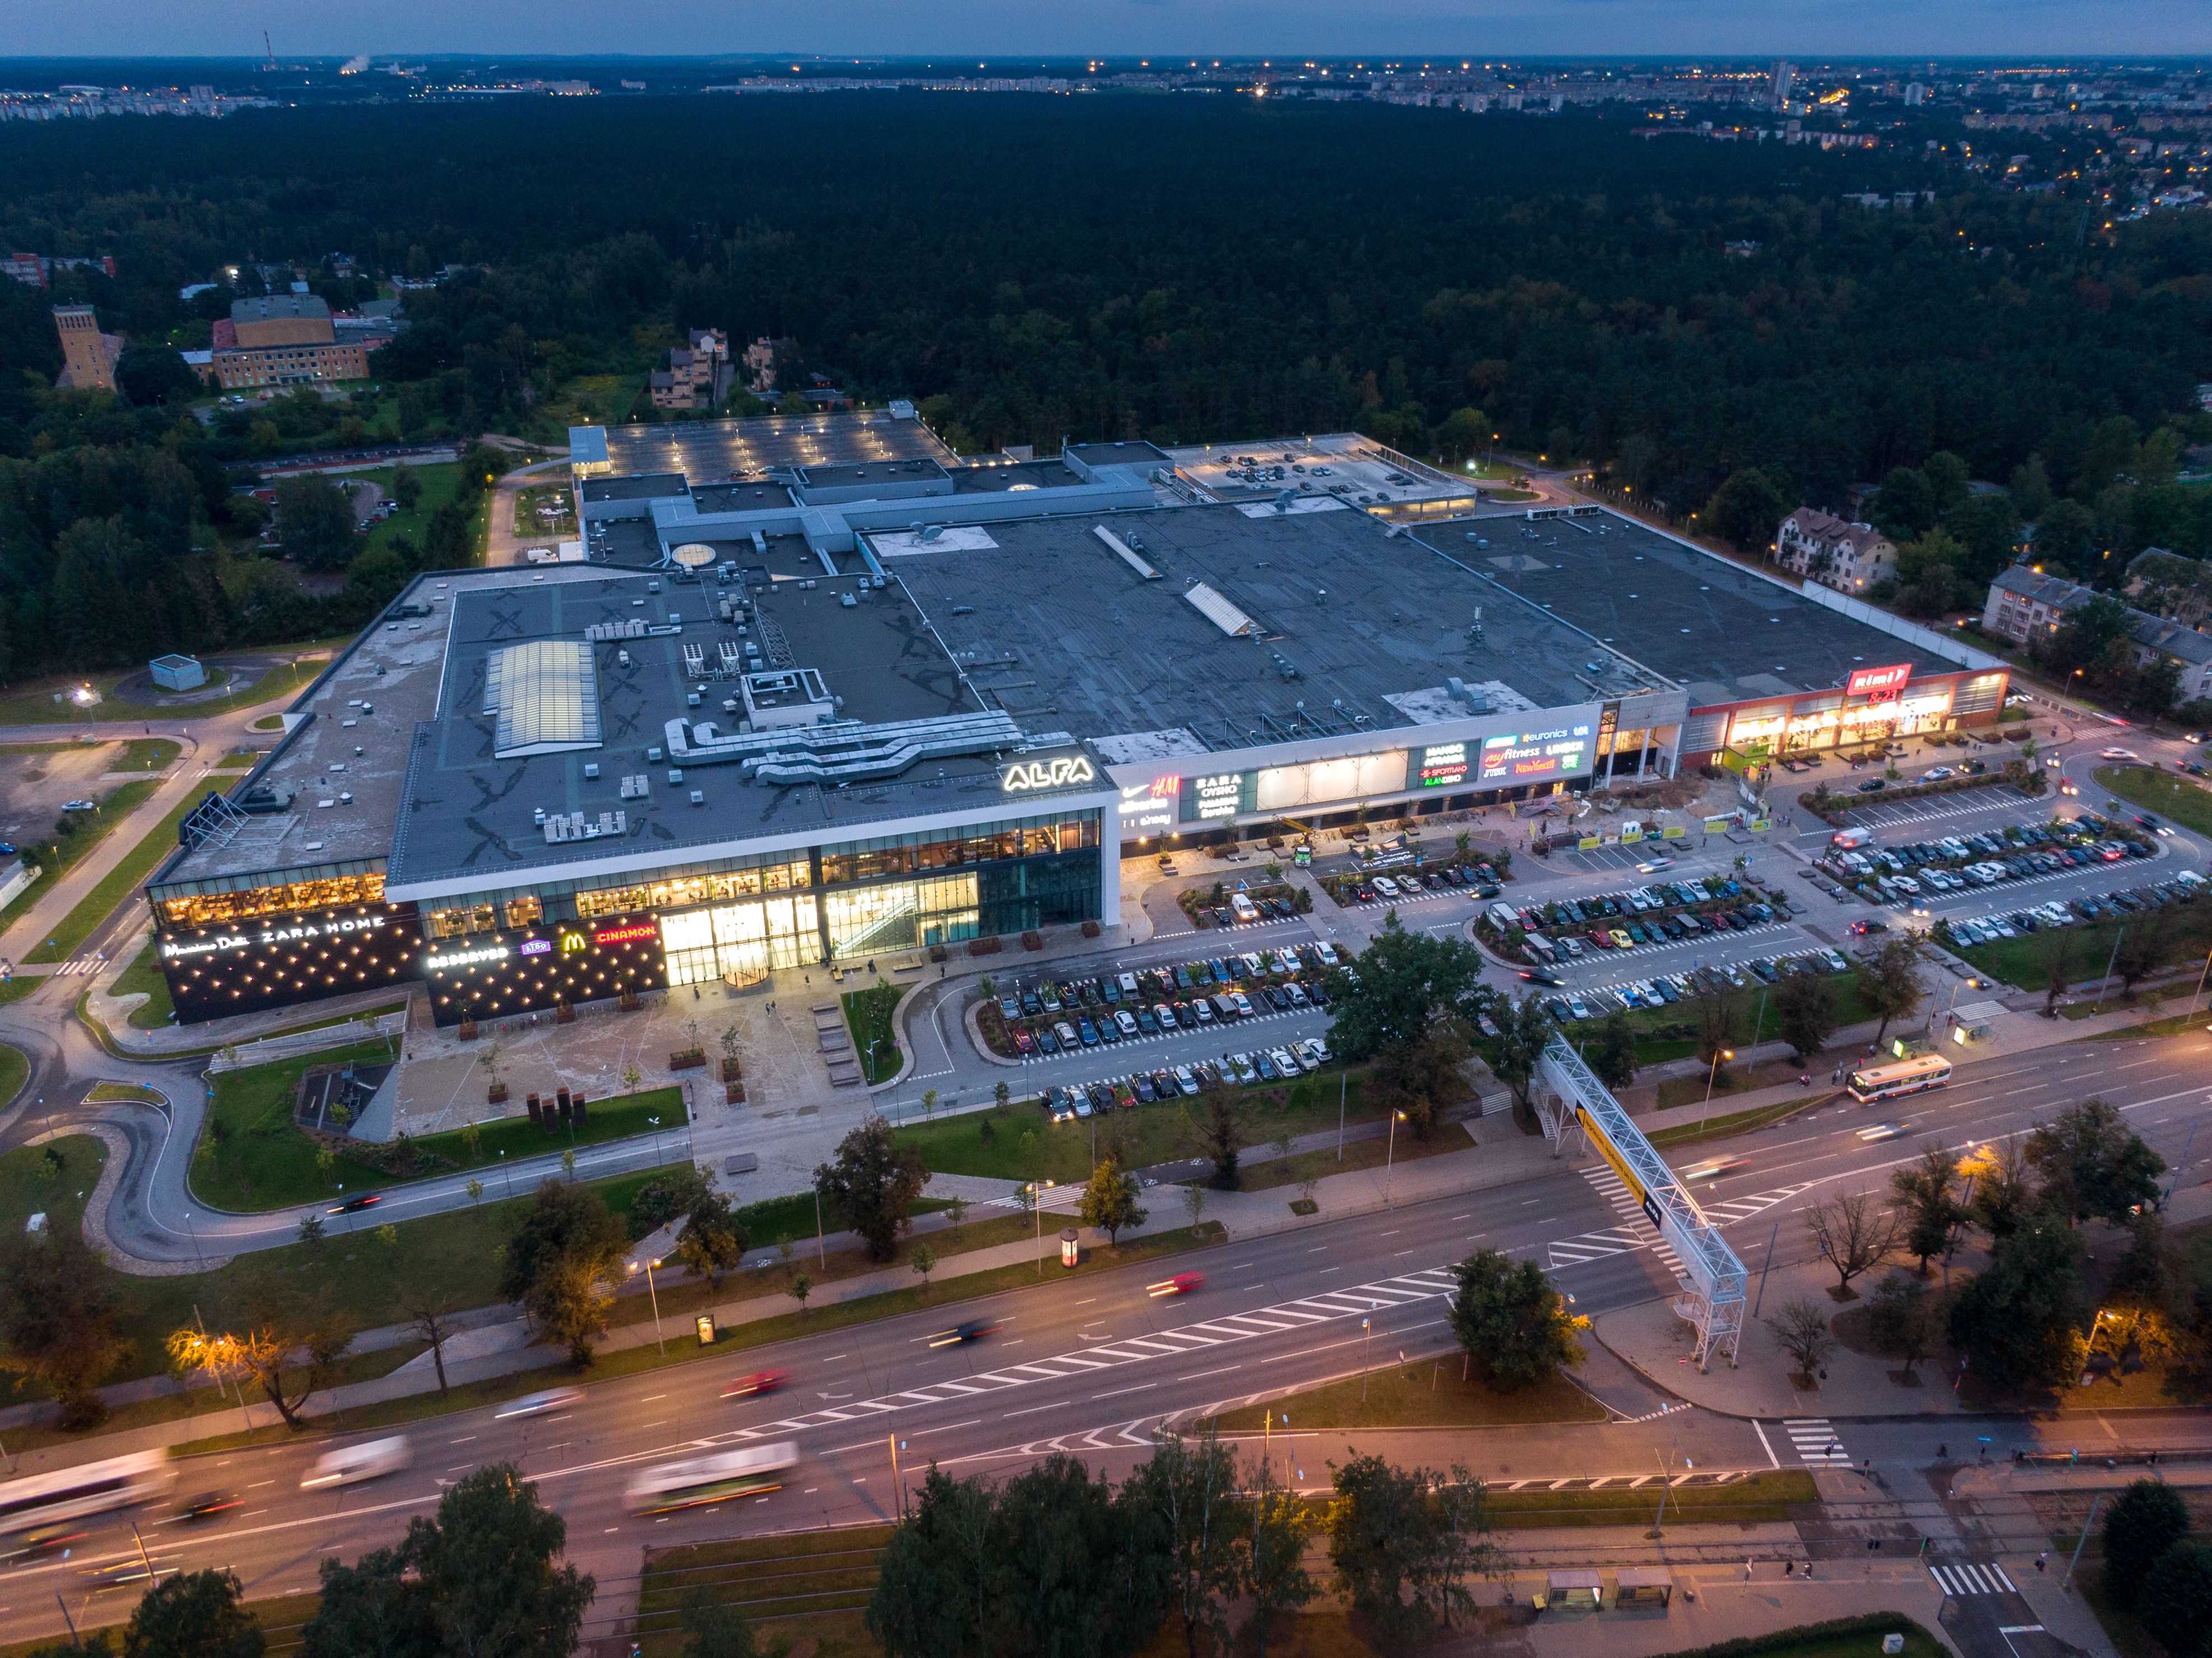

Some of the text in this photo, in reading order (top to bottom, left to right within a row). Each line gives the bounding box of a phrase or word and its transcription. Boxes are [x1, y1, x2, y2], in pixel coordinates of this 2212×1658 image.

[1869, 690, 1897, 704] 8-23
[1528, 728, 1568, 741] euronics
[1426, 744, 1463, 756] MANGO
[1004, 757, 1093, 791] ALFA
[1432, 765, 1467, 775] SPORTLAND
[1484, 767, 1507, 777] JYSK
[1151, 776, 1179, 796] H&M
[1197, 775, 1241, 789] ZARA
[1201, 784, 1237, 797] OYSHO
[1201, 806, 1235, 818] Bershka
[1140, 814, 1171, 826] sinsay
[262, 917, 385, 942] ZARA HOME
[597, 926, 656, 942] CINAMON
[164, 943, 218, 958] Massimo
[526, 943, 547, 953] LIDO
[428, 948, 509, 968] RESERVED
[1646, 1201, 1659, 1220] ALFA
